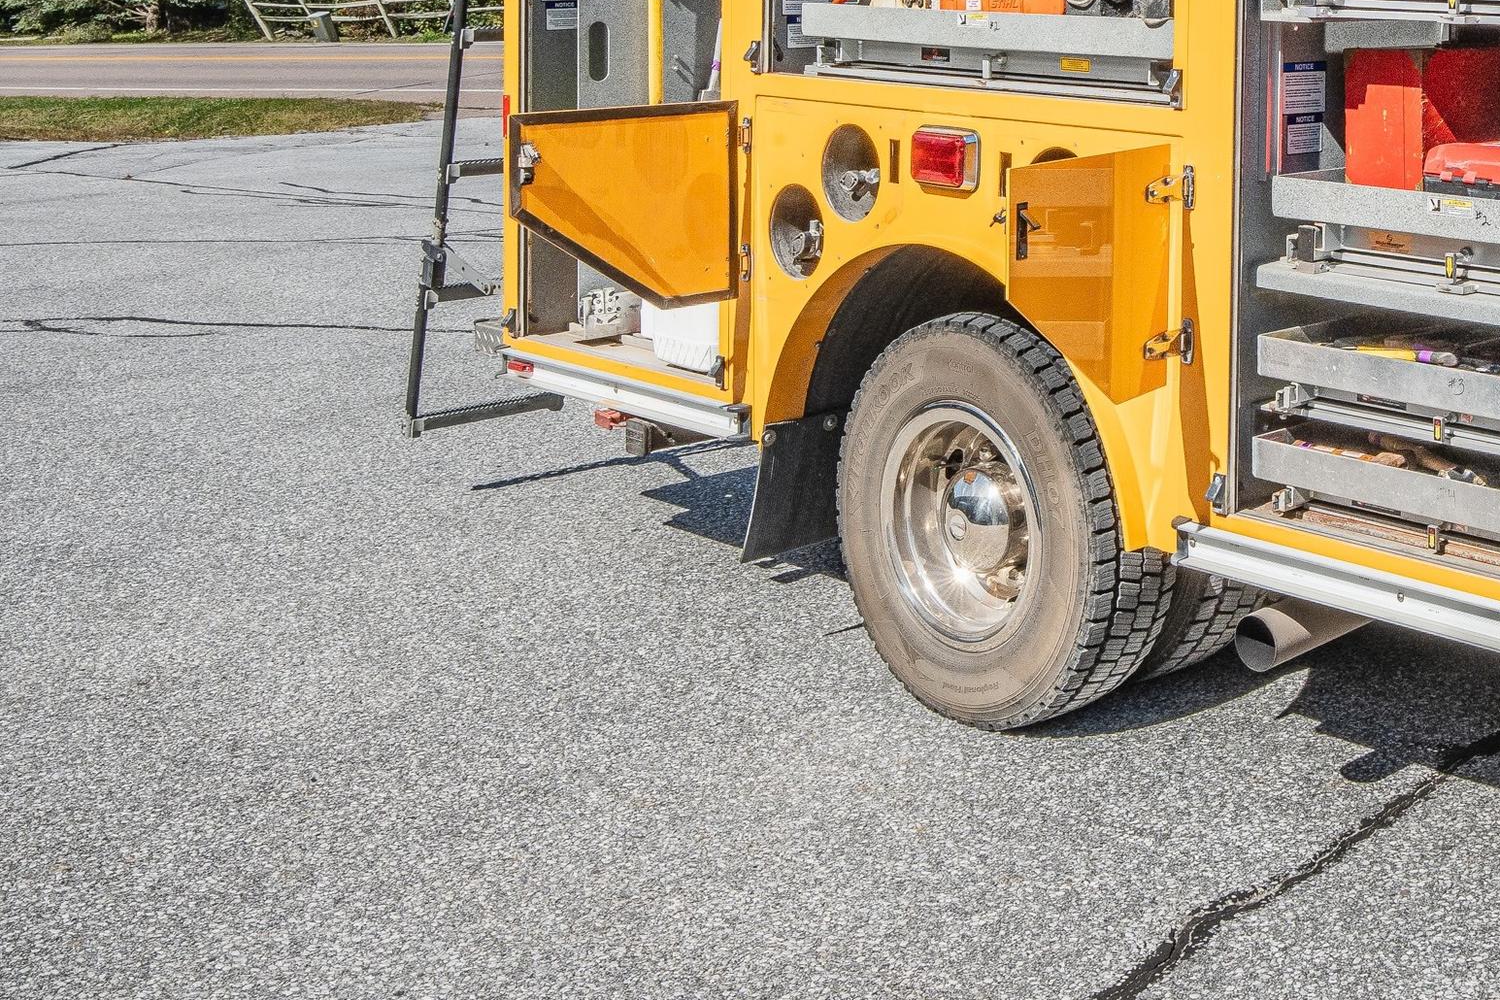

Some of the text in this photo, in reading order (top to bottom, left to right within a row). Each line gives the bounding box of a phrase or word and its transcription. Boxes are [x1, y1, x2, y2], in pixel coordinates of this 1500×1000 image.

[1294, 63, 1314, 71] NOTICE
[1296, 115, 1315, 123] NOTICE
[1448, 378, 1465, 396] #3
